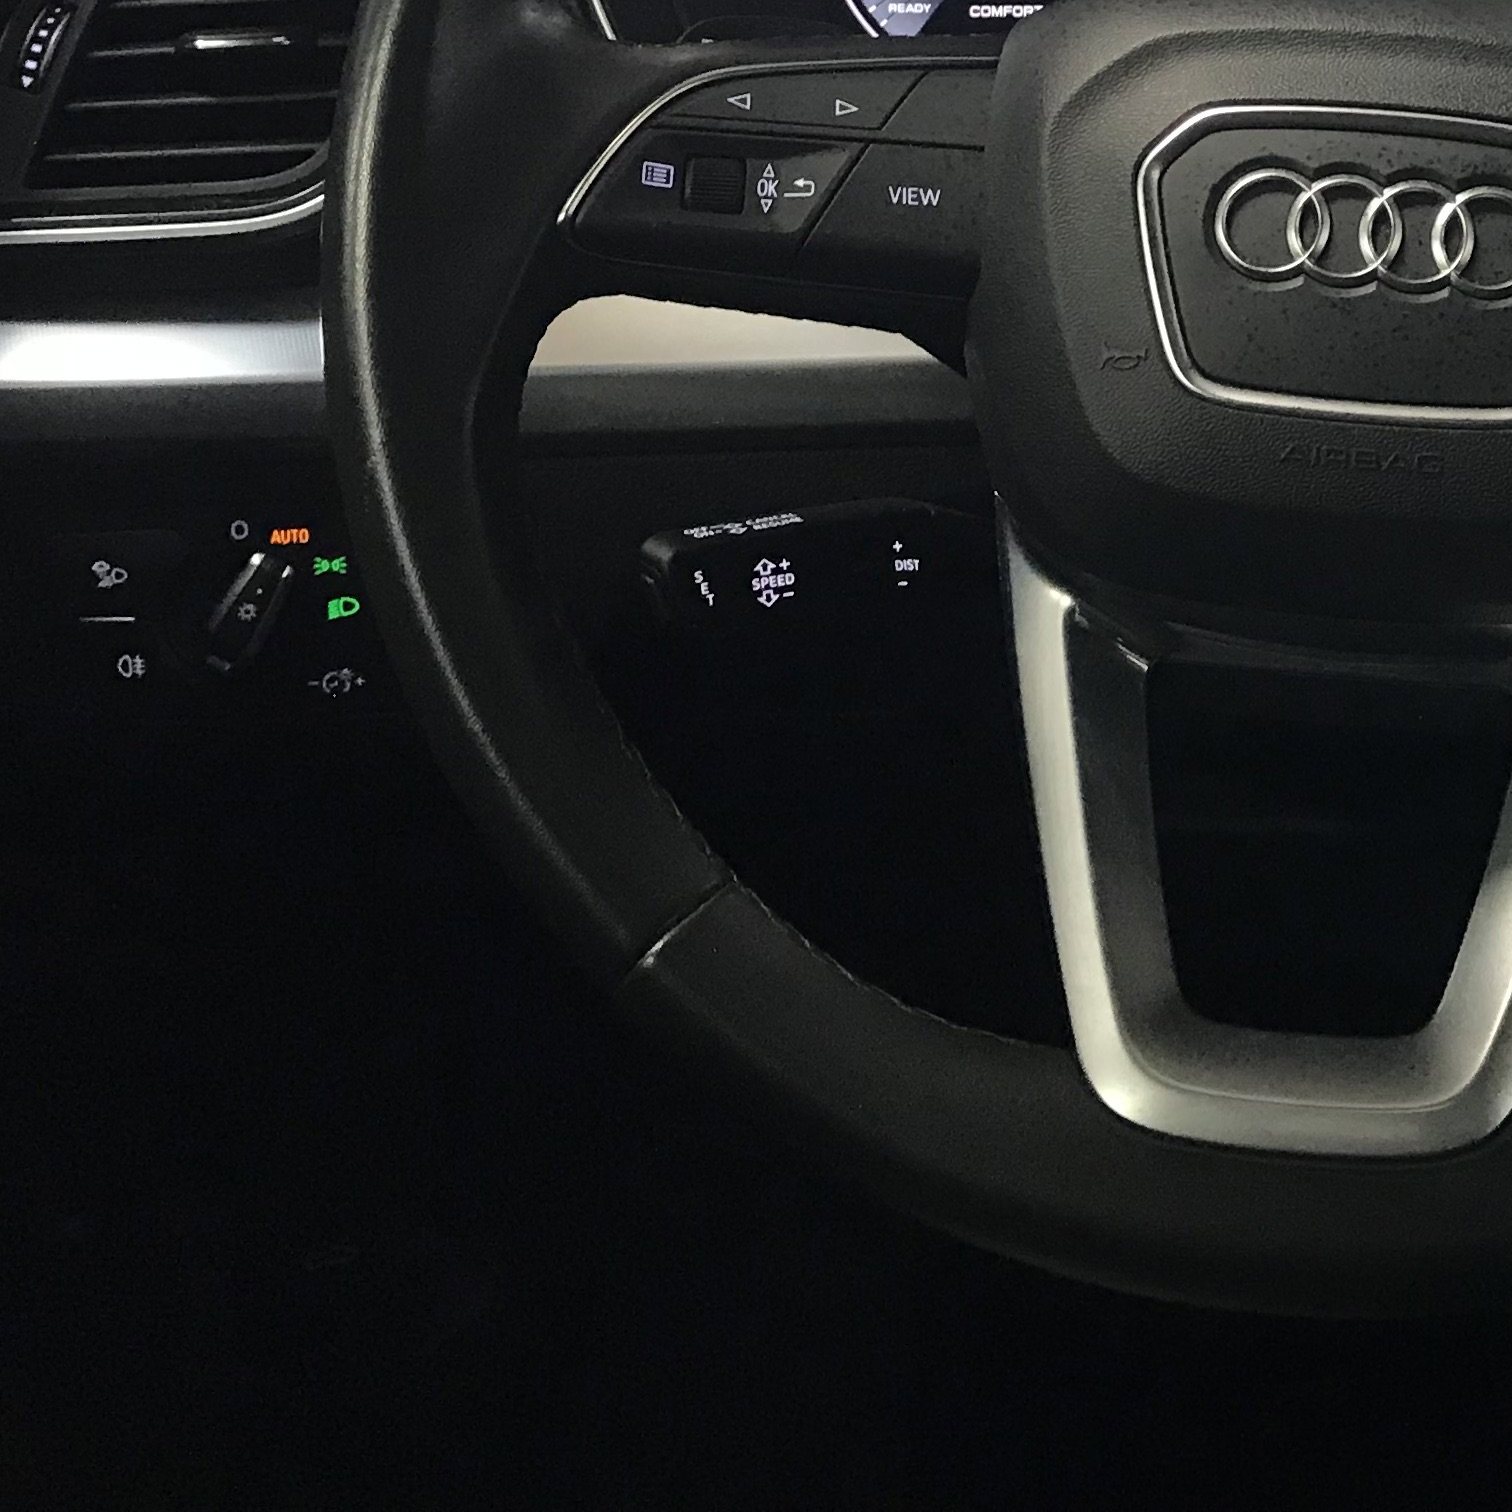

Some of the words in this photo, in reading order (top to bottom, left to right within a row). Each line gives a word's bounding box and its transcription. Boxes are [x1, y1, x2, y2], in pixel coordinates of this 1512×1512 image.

[888, 3, 931, 14] READY
[757, 179, 778, 198] OK
[889, 186, 941, 206] VIEW
[1280, 444, 1444, 474] AIRBAG
[270, 528, 310, 545] AUTO
[894, 559, 919, 571] DIST
[693, 570, 714, 606] SET
[752, 573, 795, 591] SPEED
